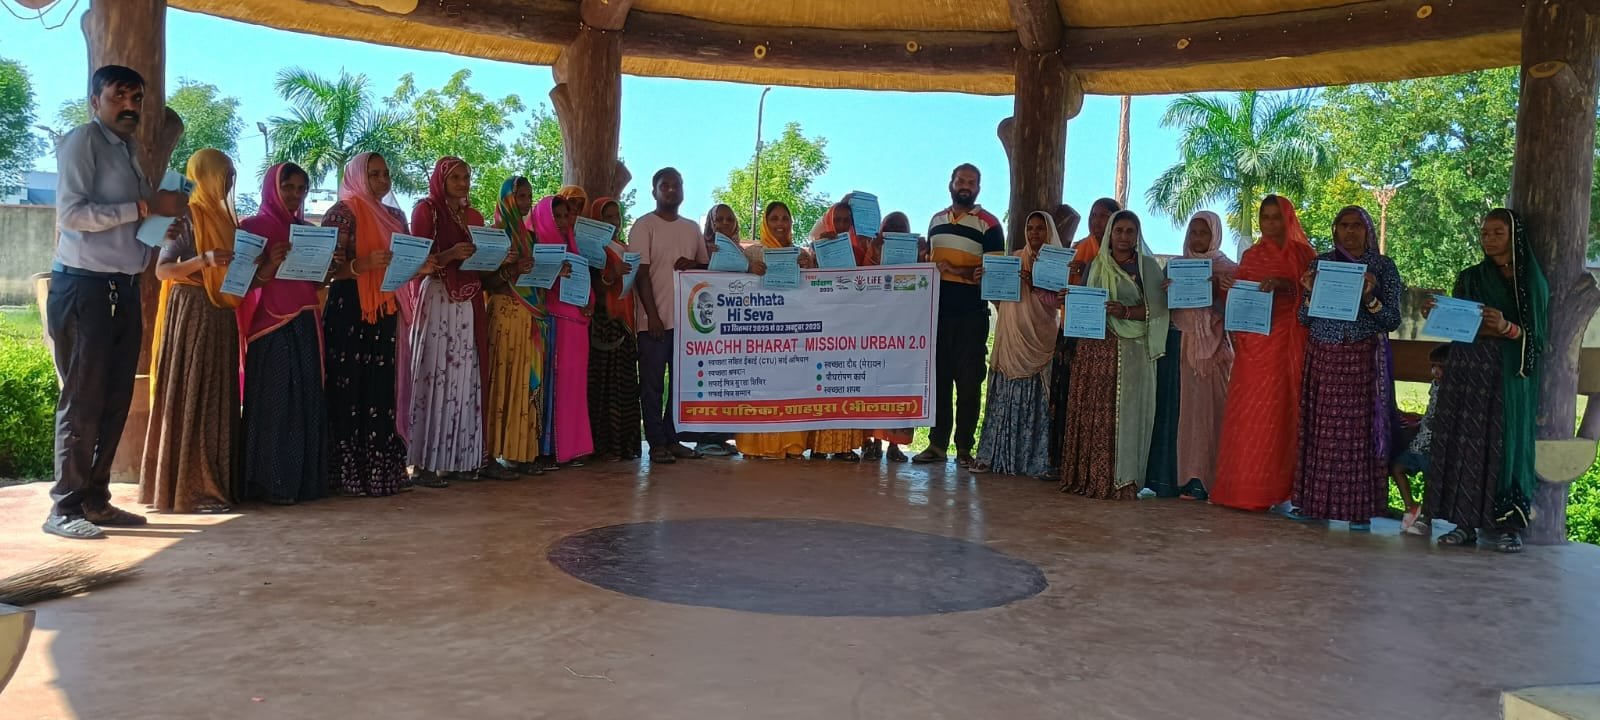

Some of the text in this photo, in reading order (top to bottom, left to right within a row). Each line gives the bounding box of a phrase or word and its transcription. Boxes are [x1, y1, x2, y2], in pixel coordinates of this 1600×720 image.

[717, 292, 784, 307] Swachhata
[728, 308, 774, 322] Hi Seva
[805, 322, 821, 330] 2025
[686, 335, 926, 356] SWACHH BHARAT MISSION URBAN 2.0
[824, 361, 845, 369] स्वच्छता
[824, 386, 845, 394] स्वच्छता
[686, 406, 718, 416] नगर
